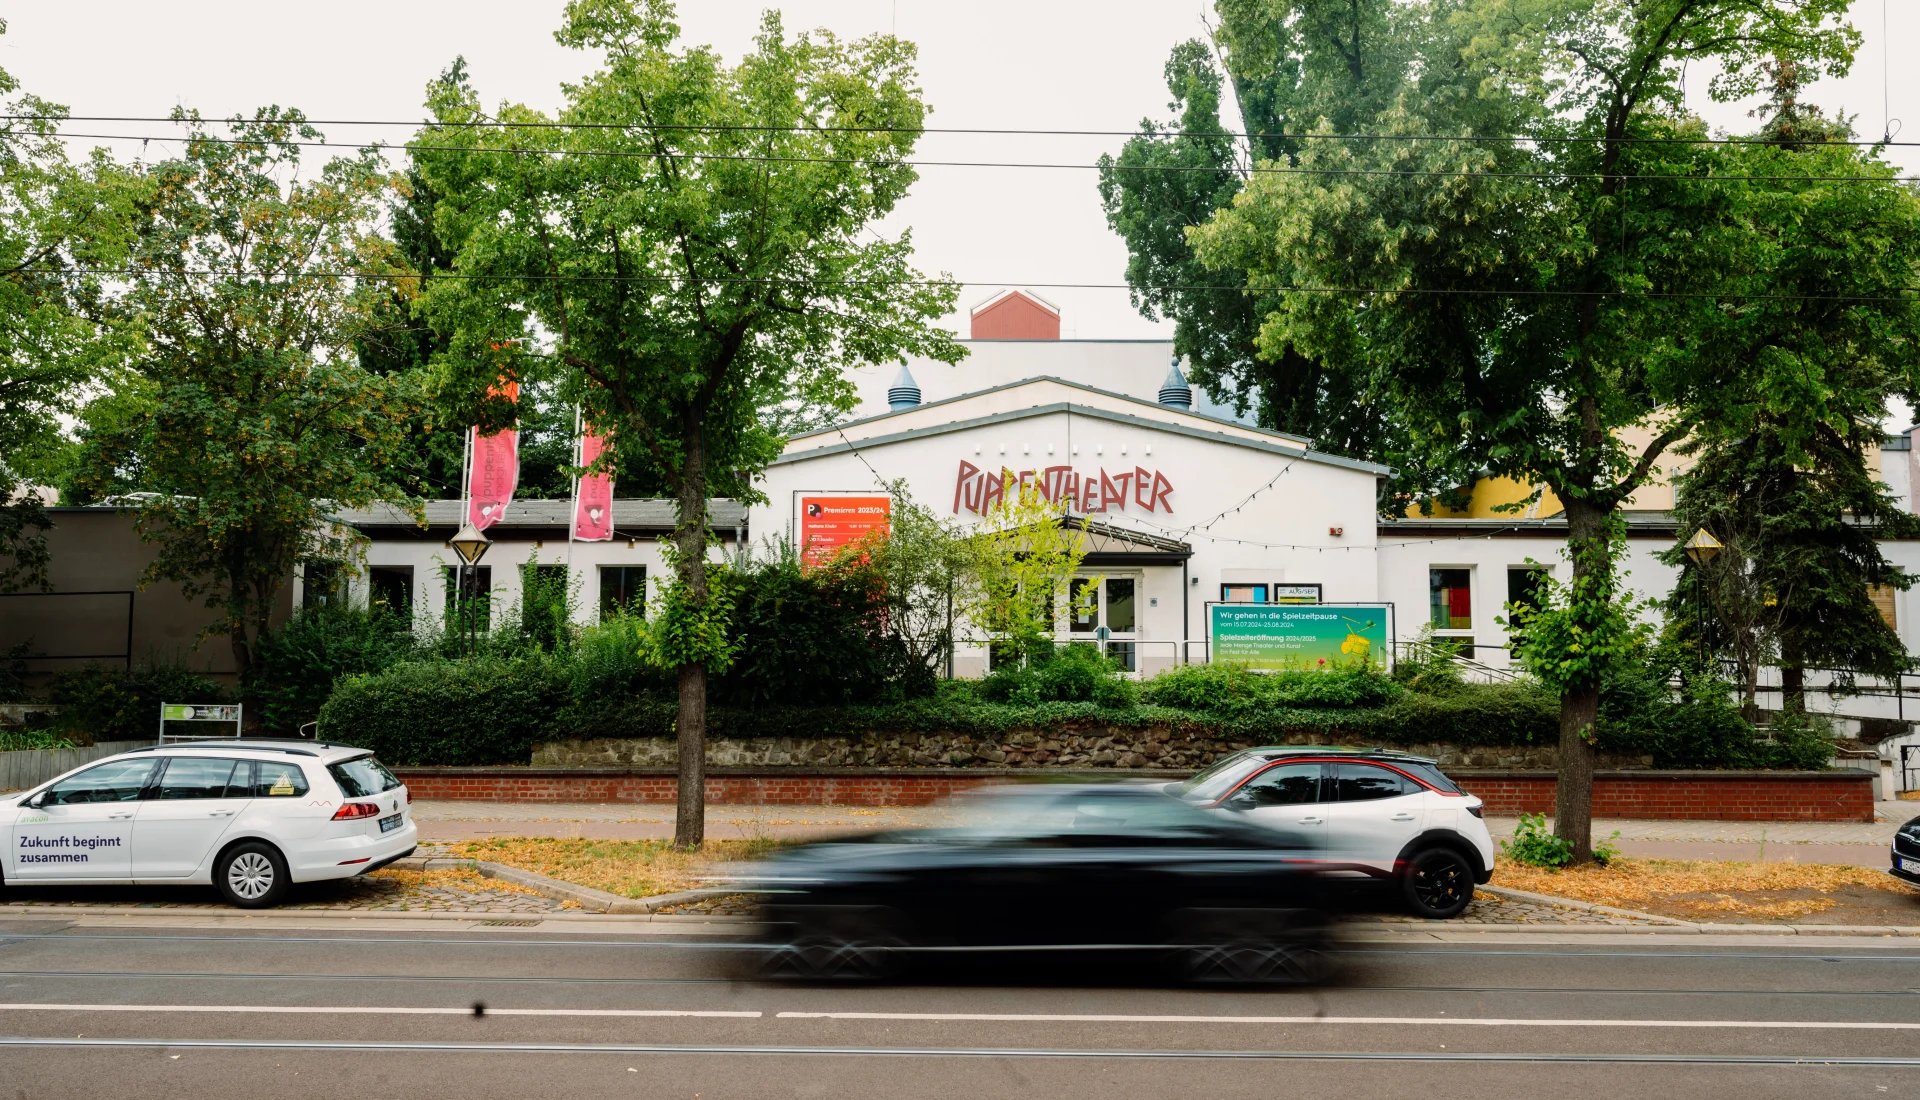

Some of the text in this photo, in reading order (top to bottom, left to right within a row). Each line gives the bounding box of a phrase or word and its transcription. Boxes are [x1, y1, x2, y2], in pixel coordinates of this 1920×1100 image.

[953, 459, 1174, 517] PUPPENTHEATER
[807, 504, 815, 514] P
[1234, 612, 1258, 620] gehen
[1268, 612, 1281, 620] die
[1282, 612, 1338, 621] Spielzeitpause
[1220, 634, 1285, 643] Spielzeiteröffnung
[20, 835, 121, 850] Zukunft beginnt
[20, 854, 89, 863] zusammen
